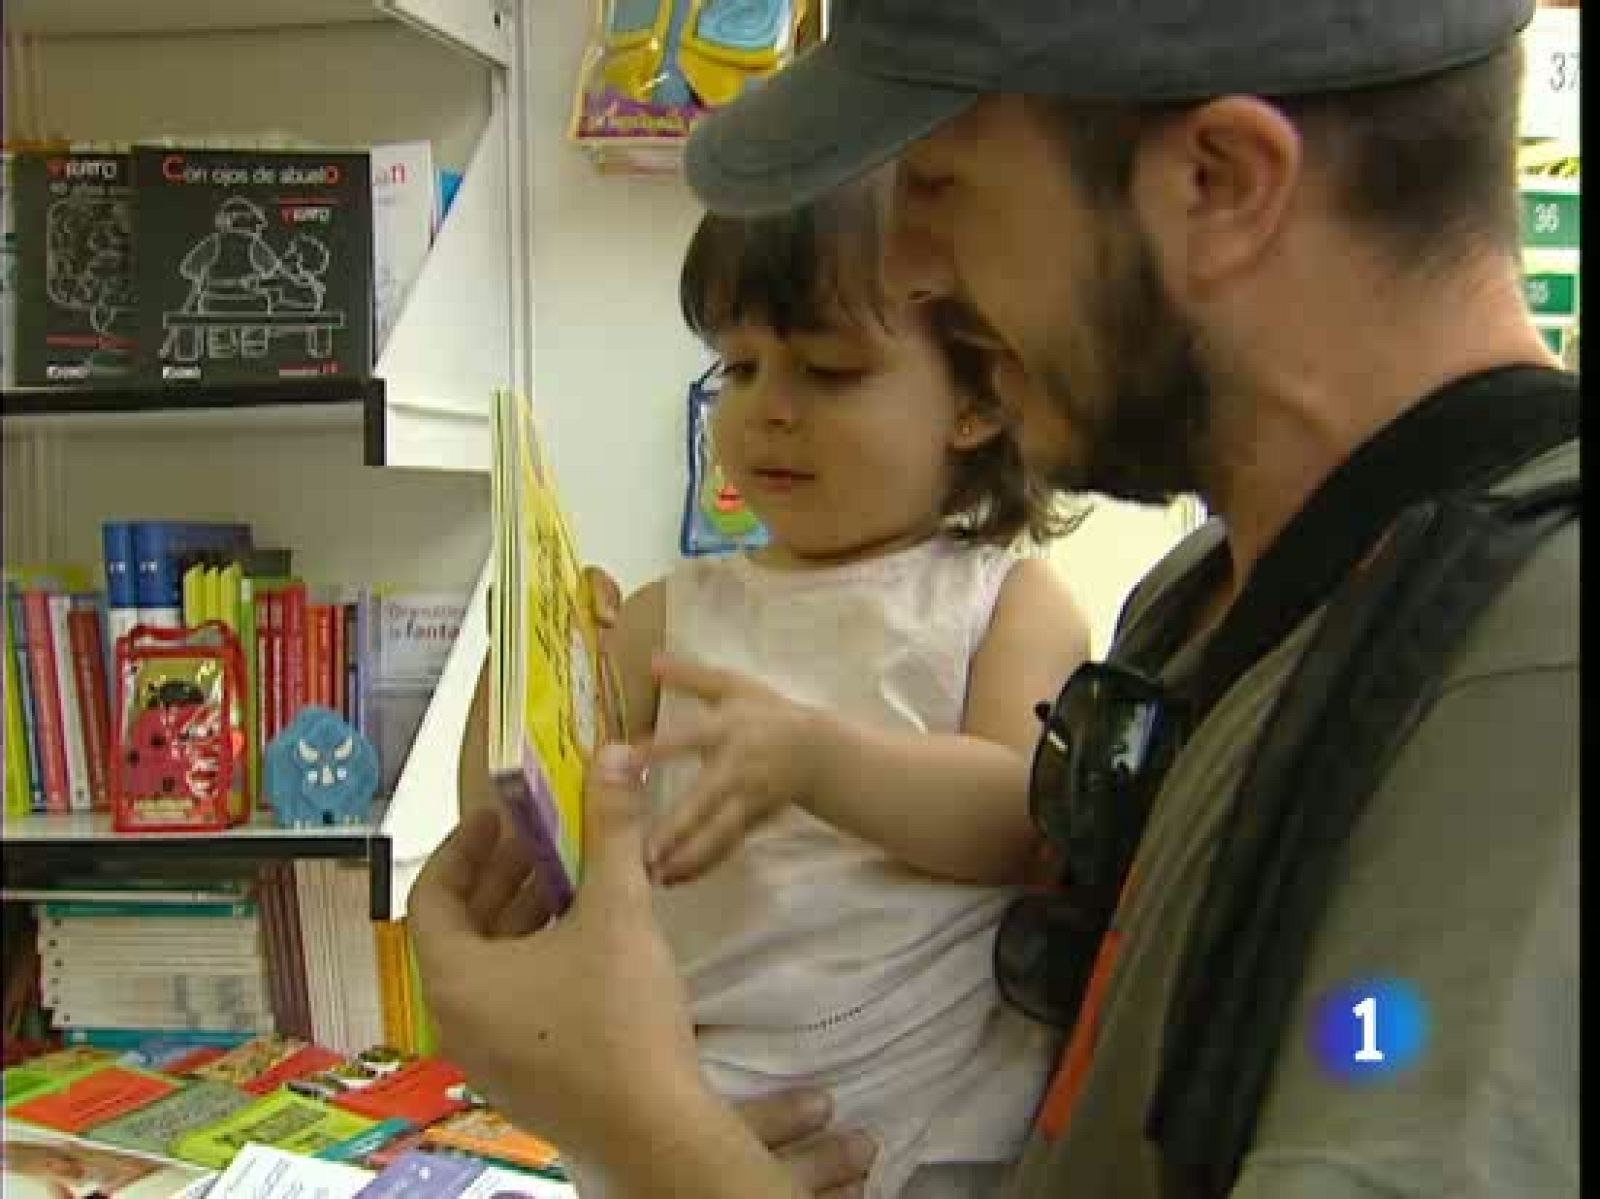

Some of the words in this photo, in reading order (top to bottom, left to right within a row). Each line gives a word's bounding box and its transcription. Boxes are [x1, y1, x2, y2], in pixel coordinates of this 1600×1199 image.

[162, 154, 208, 184] Con
[212, 166, 249, 188] ojos
[253, 164, 275, 185] de
